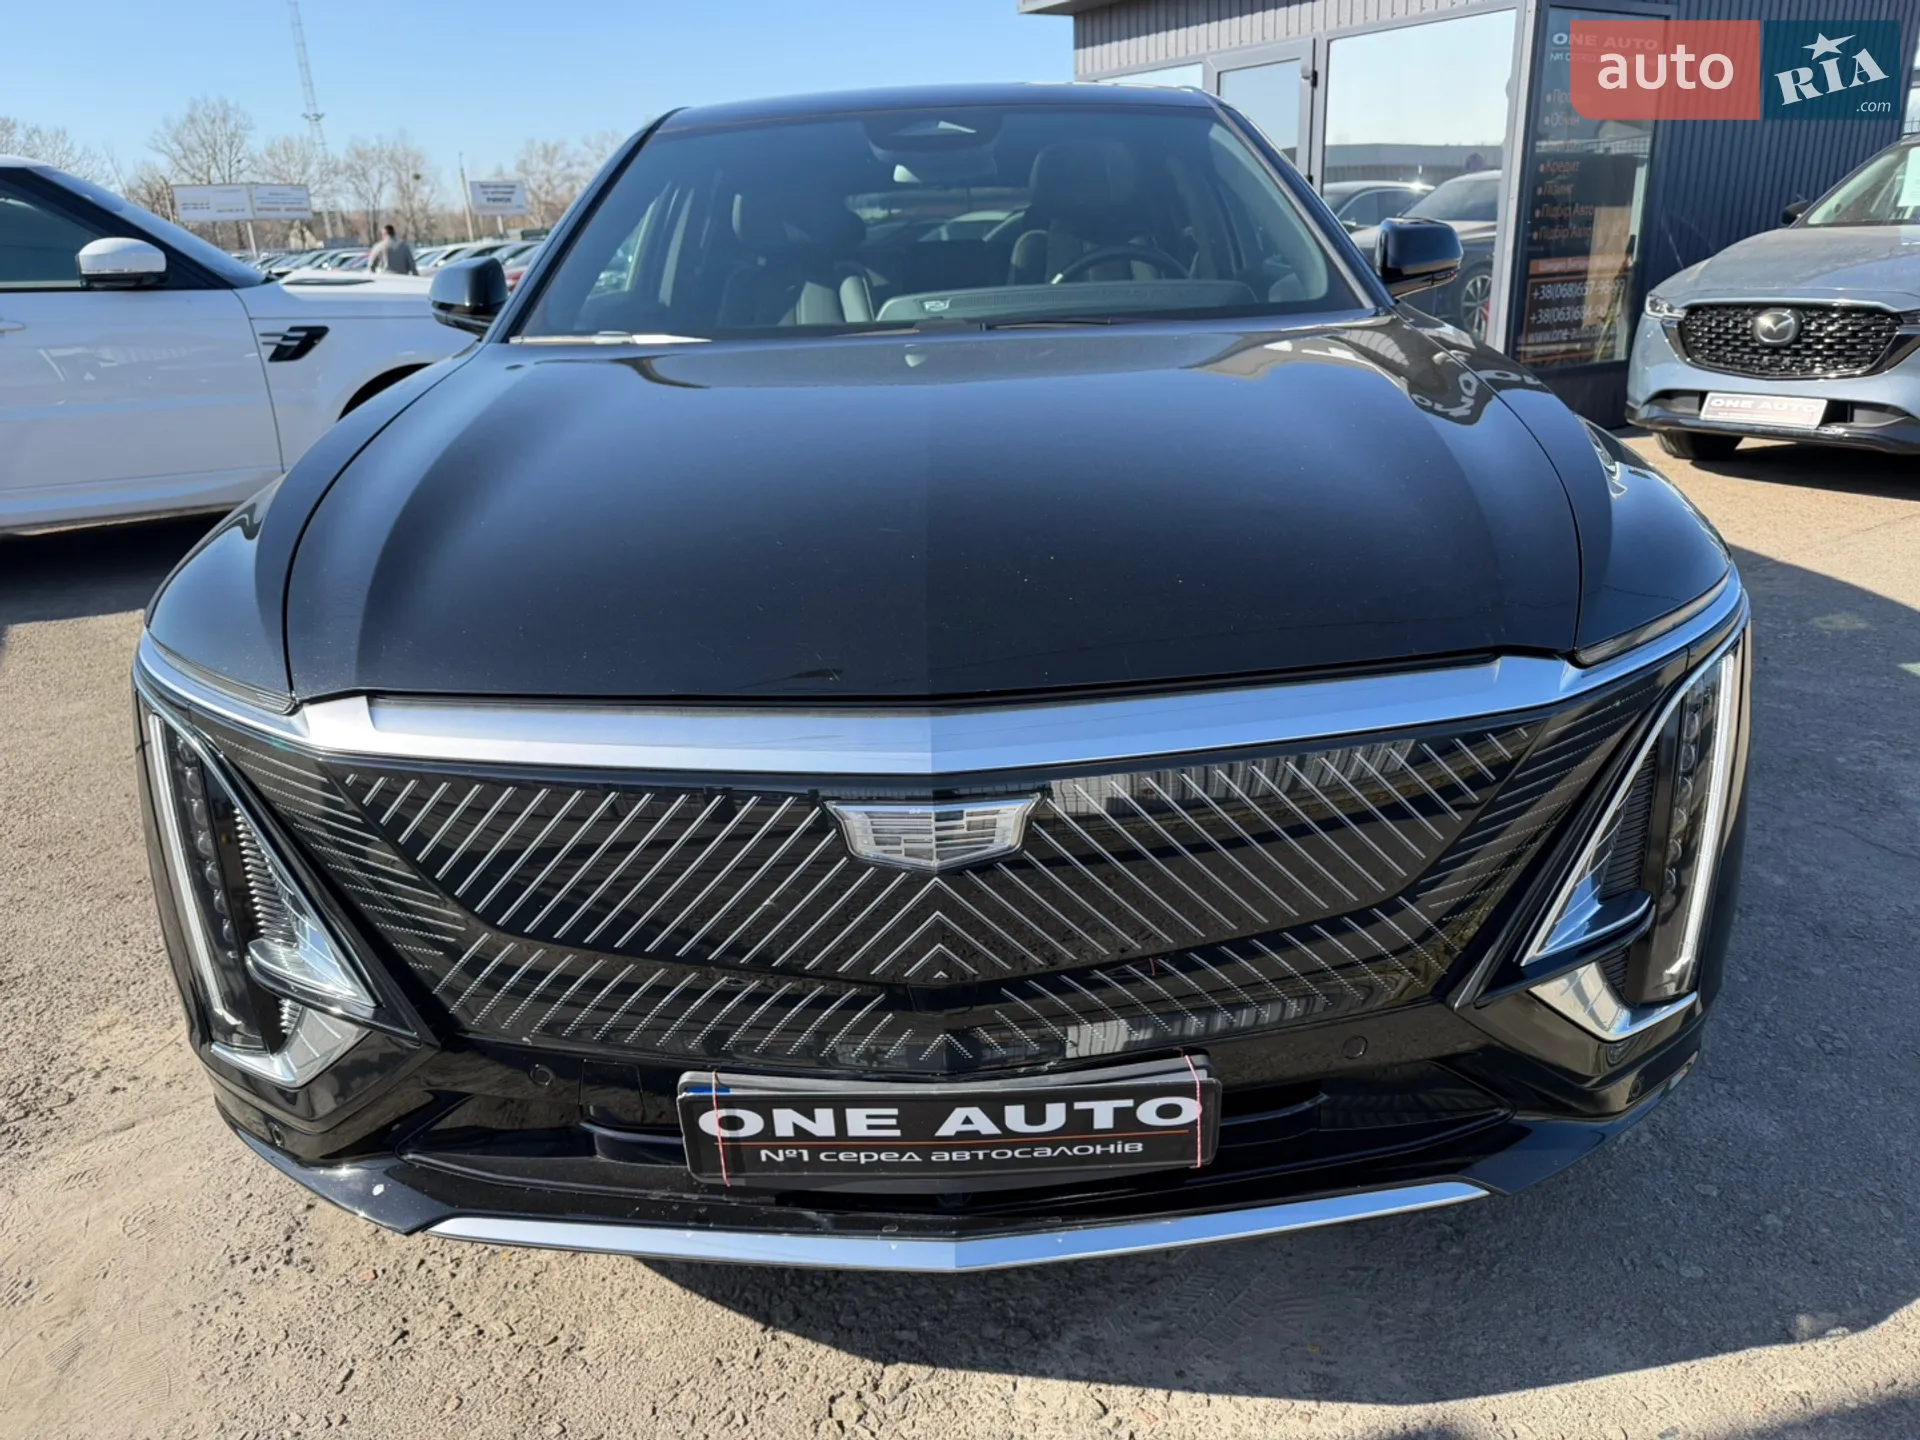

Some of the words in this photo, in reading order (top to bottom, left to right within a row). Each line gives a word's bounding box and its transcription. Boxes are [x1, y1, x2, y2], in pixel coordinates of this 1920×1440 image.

[1552, 33, 1597, 46] ONE
[1604, 36, 1658, 51] AUTO
[1545, 160, 1580, 176] Кредит
[1710, 398, 1753, 409] ONE
[1758, 400, 1817, 413] AUTO
[698, 1107, 902, 1138] ONE
[933, 1096, 1203, 1137] AUTO
[759, 1148, 809, 1163] №1
[820, 1150, 923, 1163] серед
[930, 1141, 1144, 1162] автосалонів
